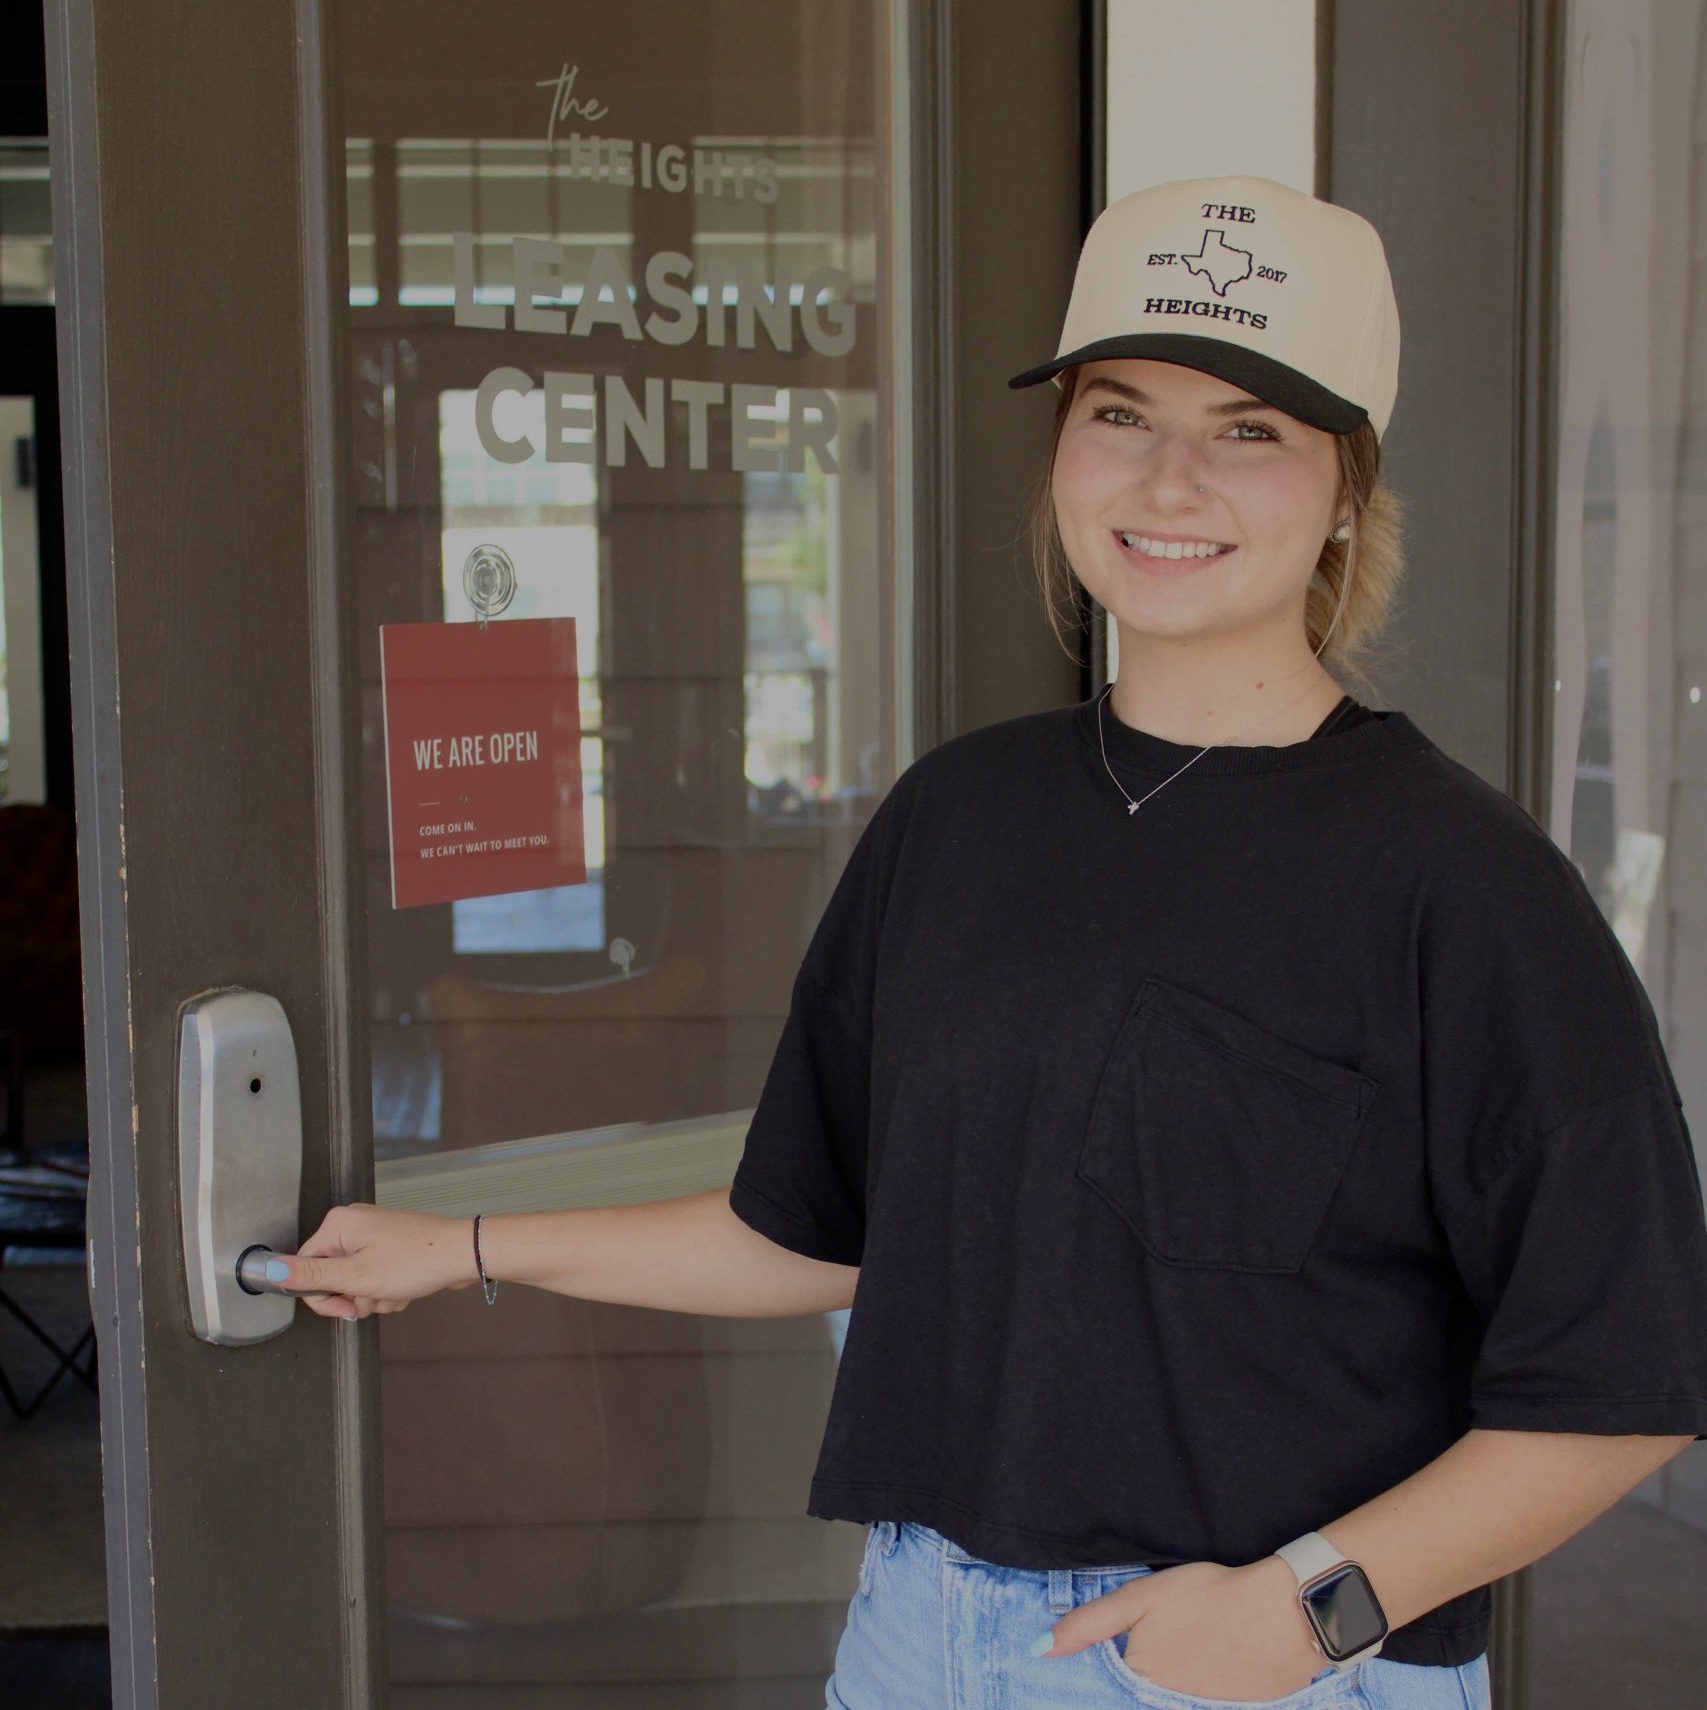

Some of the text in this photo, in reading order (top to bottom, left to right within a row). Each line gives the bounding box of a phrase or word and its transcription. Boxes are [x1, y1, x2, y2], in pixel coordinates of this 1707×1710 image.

[536, 63, 608, 152] the
[570, 132, 779, 204] HEIGHTS
[1201, 203, 1256, 224] THE
[1147, 254, 1288, 284] EST. 2017
[453, 230, 856, 357] LEASING
[1143, 298, 1268, 330] HEIGHTS
[475, 366, 839, 474] CENTER
[413, 731, 538, 770] WE ARE OPEN
[420, 821, 477, 836] COME ON IN.
[420, 835, 550, 859] WE CAN'T WAIT TO MEET YOU.
